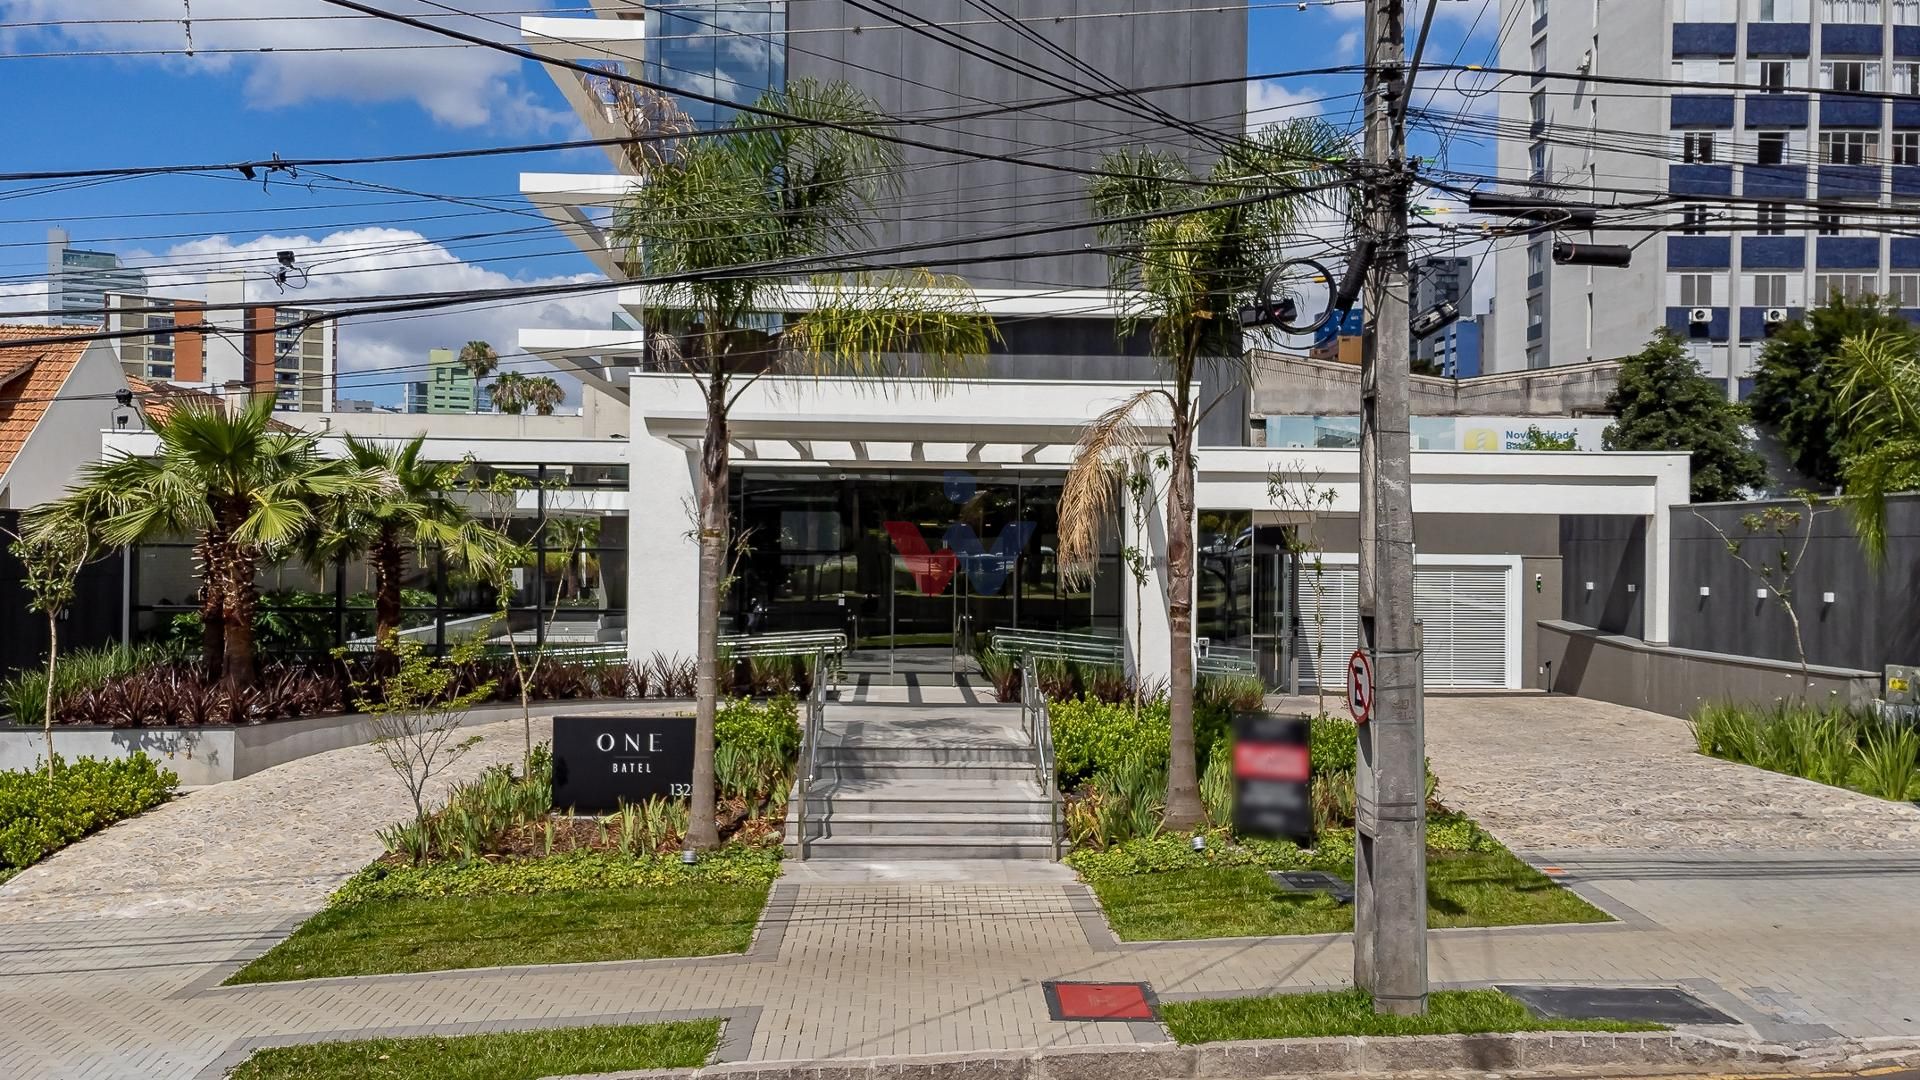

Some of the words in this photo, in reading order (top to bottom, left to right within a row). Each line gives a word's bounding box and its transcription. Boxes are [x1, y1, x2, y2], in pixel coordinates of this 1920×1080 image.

[596, 732, 663, 752] ONE
[612, 763, 652, 773] BATEL
[670, 783, 693, 796] 132
